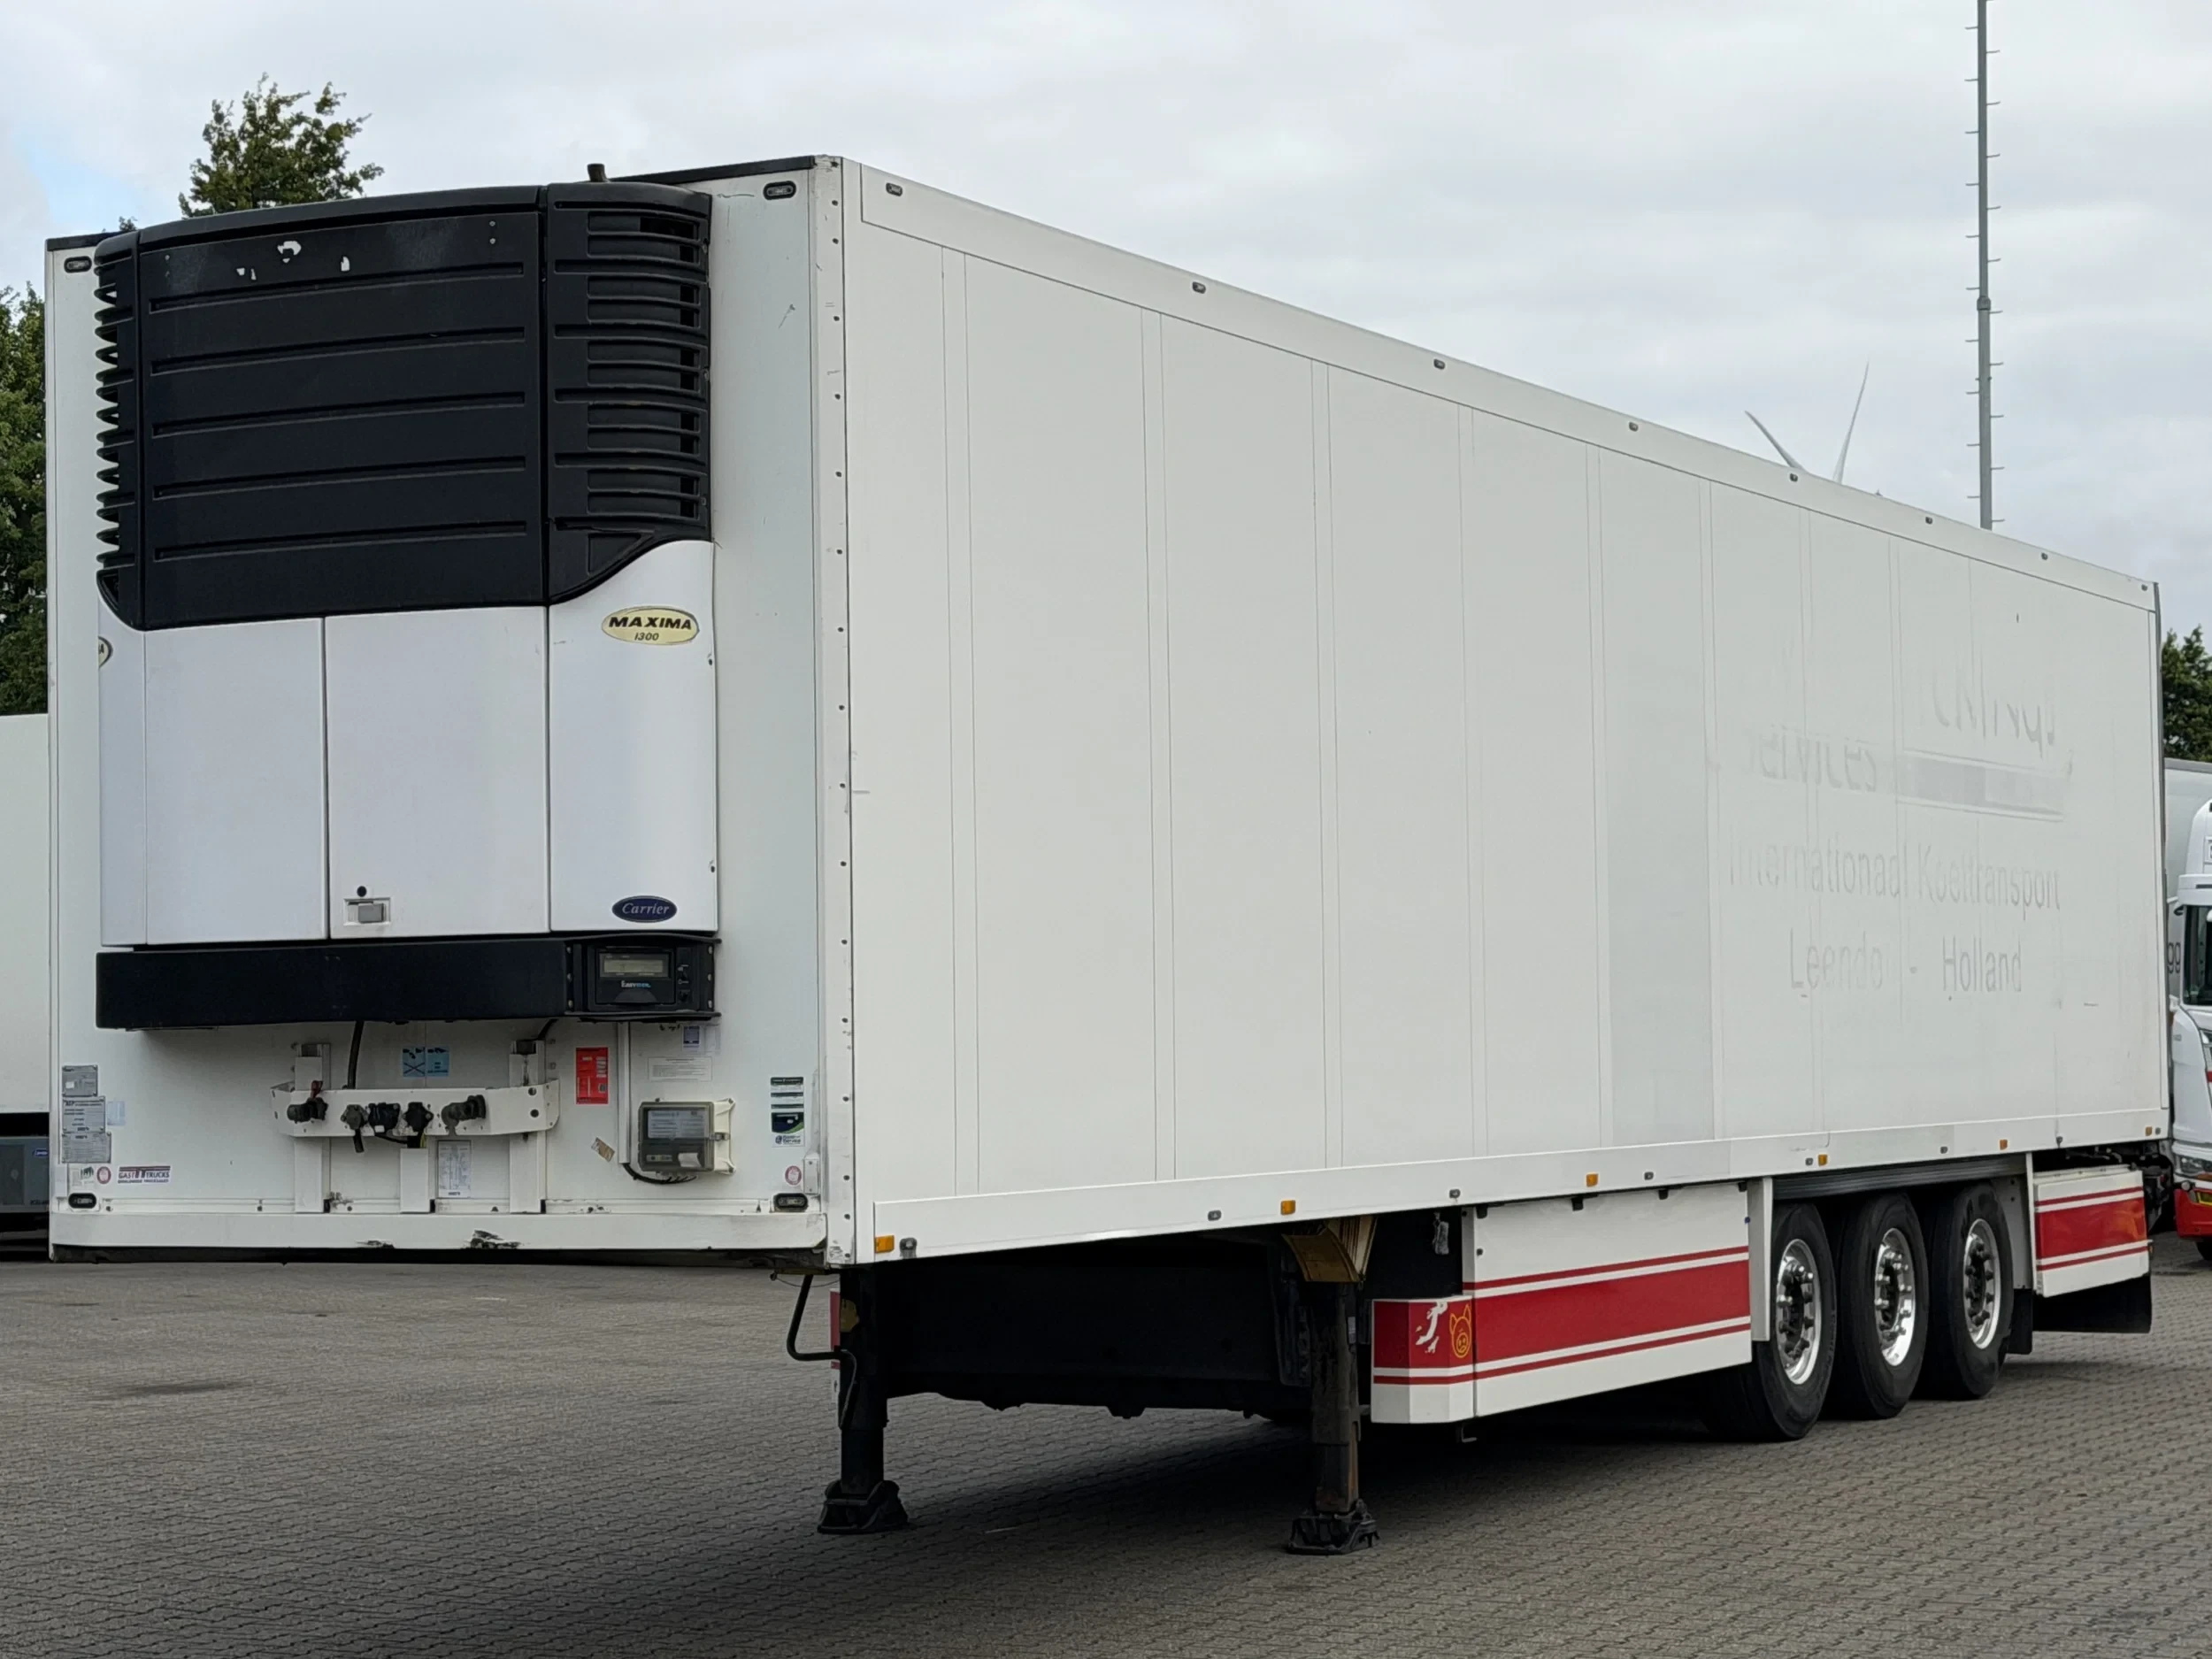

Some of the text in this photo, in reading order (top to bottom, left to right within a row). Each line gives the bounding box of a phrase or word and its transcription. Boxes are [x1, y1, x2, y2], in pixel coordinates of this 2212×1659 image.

[608, 616, 692, 630] MAXIMA
[634, 632, 659, 641] 1300
[621, 902, 670, 915] Carrier
[1942, 934, 2023, 993] Holland
